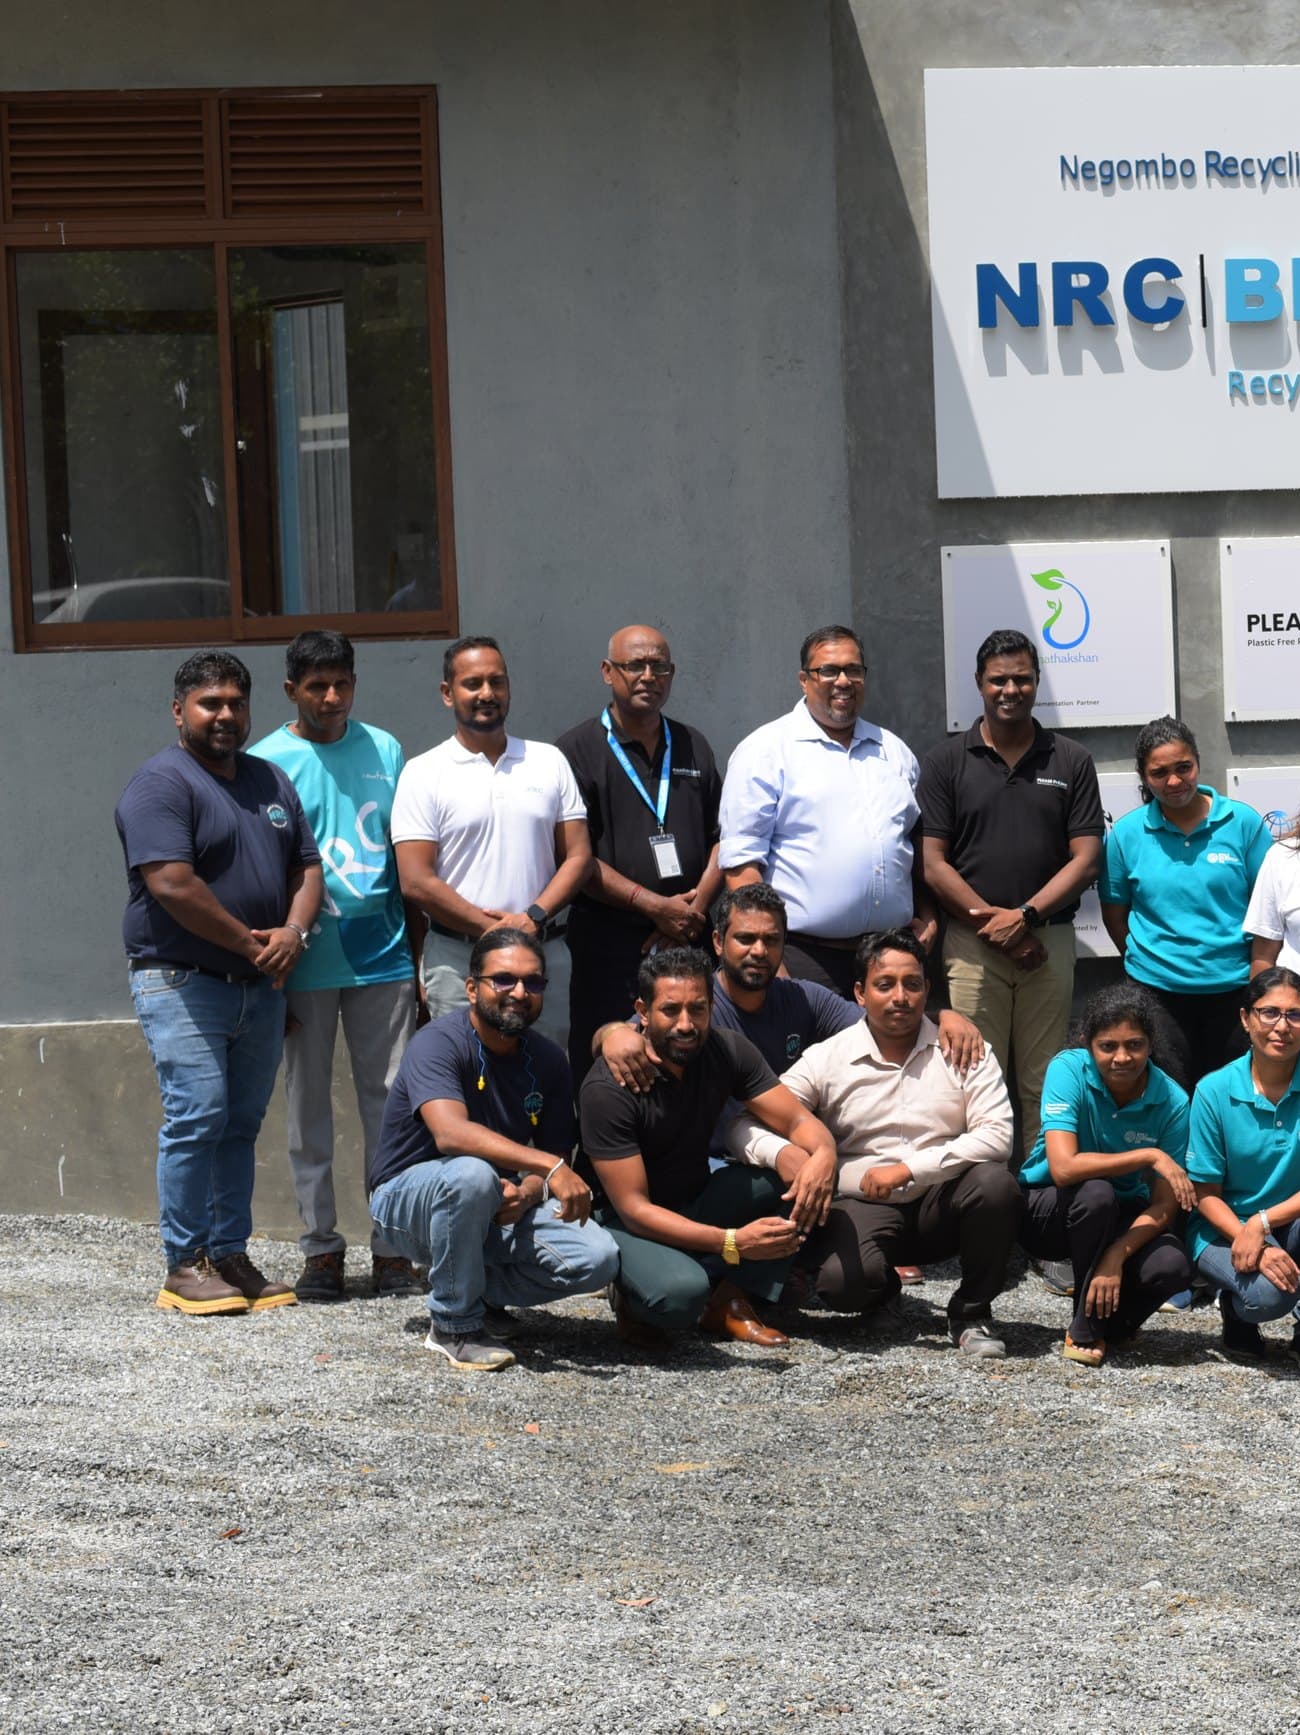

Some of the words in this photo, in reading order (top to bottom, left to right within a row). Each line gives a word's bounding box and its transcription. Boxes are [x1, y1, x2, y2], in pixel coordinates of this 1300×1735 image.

[1059, 155, 1196, 185] Negombo
[975, 257, 1185, 328] NRC
[1247, 638, 1275, 647] Plastic
[1277, 638, 1296, 646] Free
